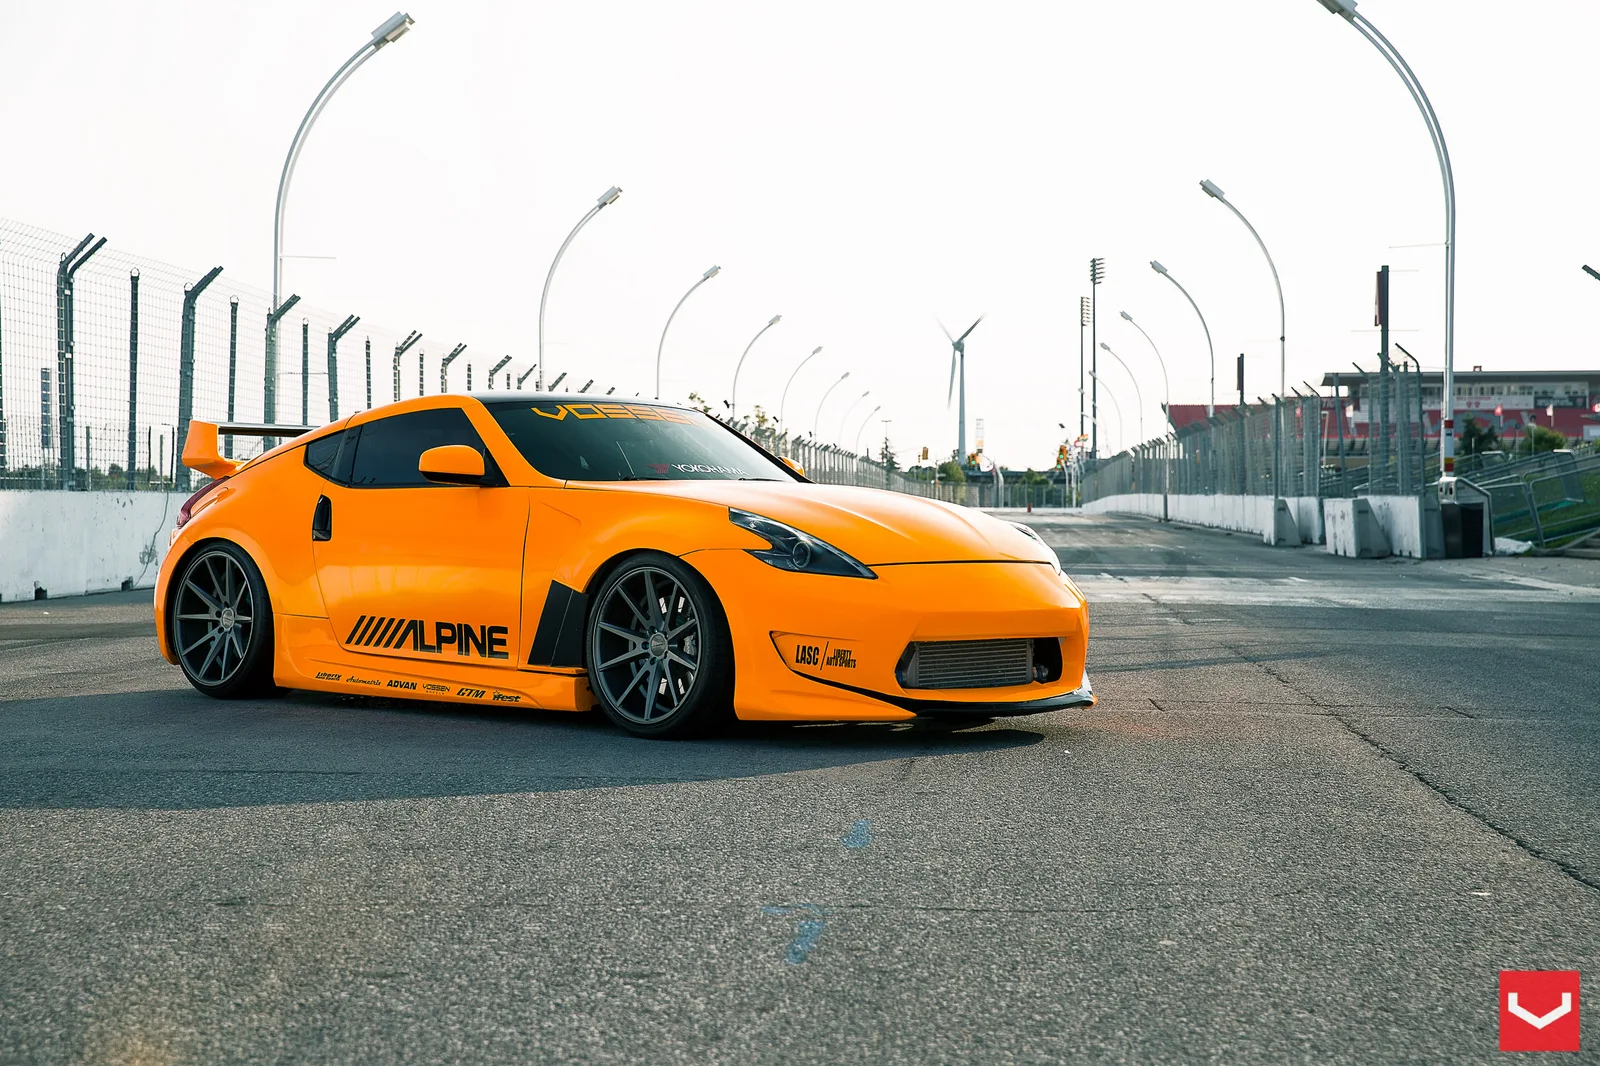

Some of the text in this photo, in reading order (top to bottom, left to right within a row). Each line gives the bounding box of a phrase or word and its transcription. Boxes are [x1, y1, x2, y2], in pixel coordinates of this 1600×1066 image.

[671, 463, 750, 476] YOKOHAMA
[796, 645, 819, 666] LASC
[834, 649, 852, 659] LIBERTY
[826, 657, 856, 668] AUTO SPORTS
[387, 680, 417, 690] ADVAN
[422, 683, 451, 692] VOSSEN
[456, 687, 487, 699] GTM
